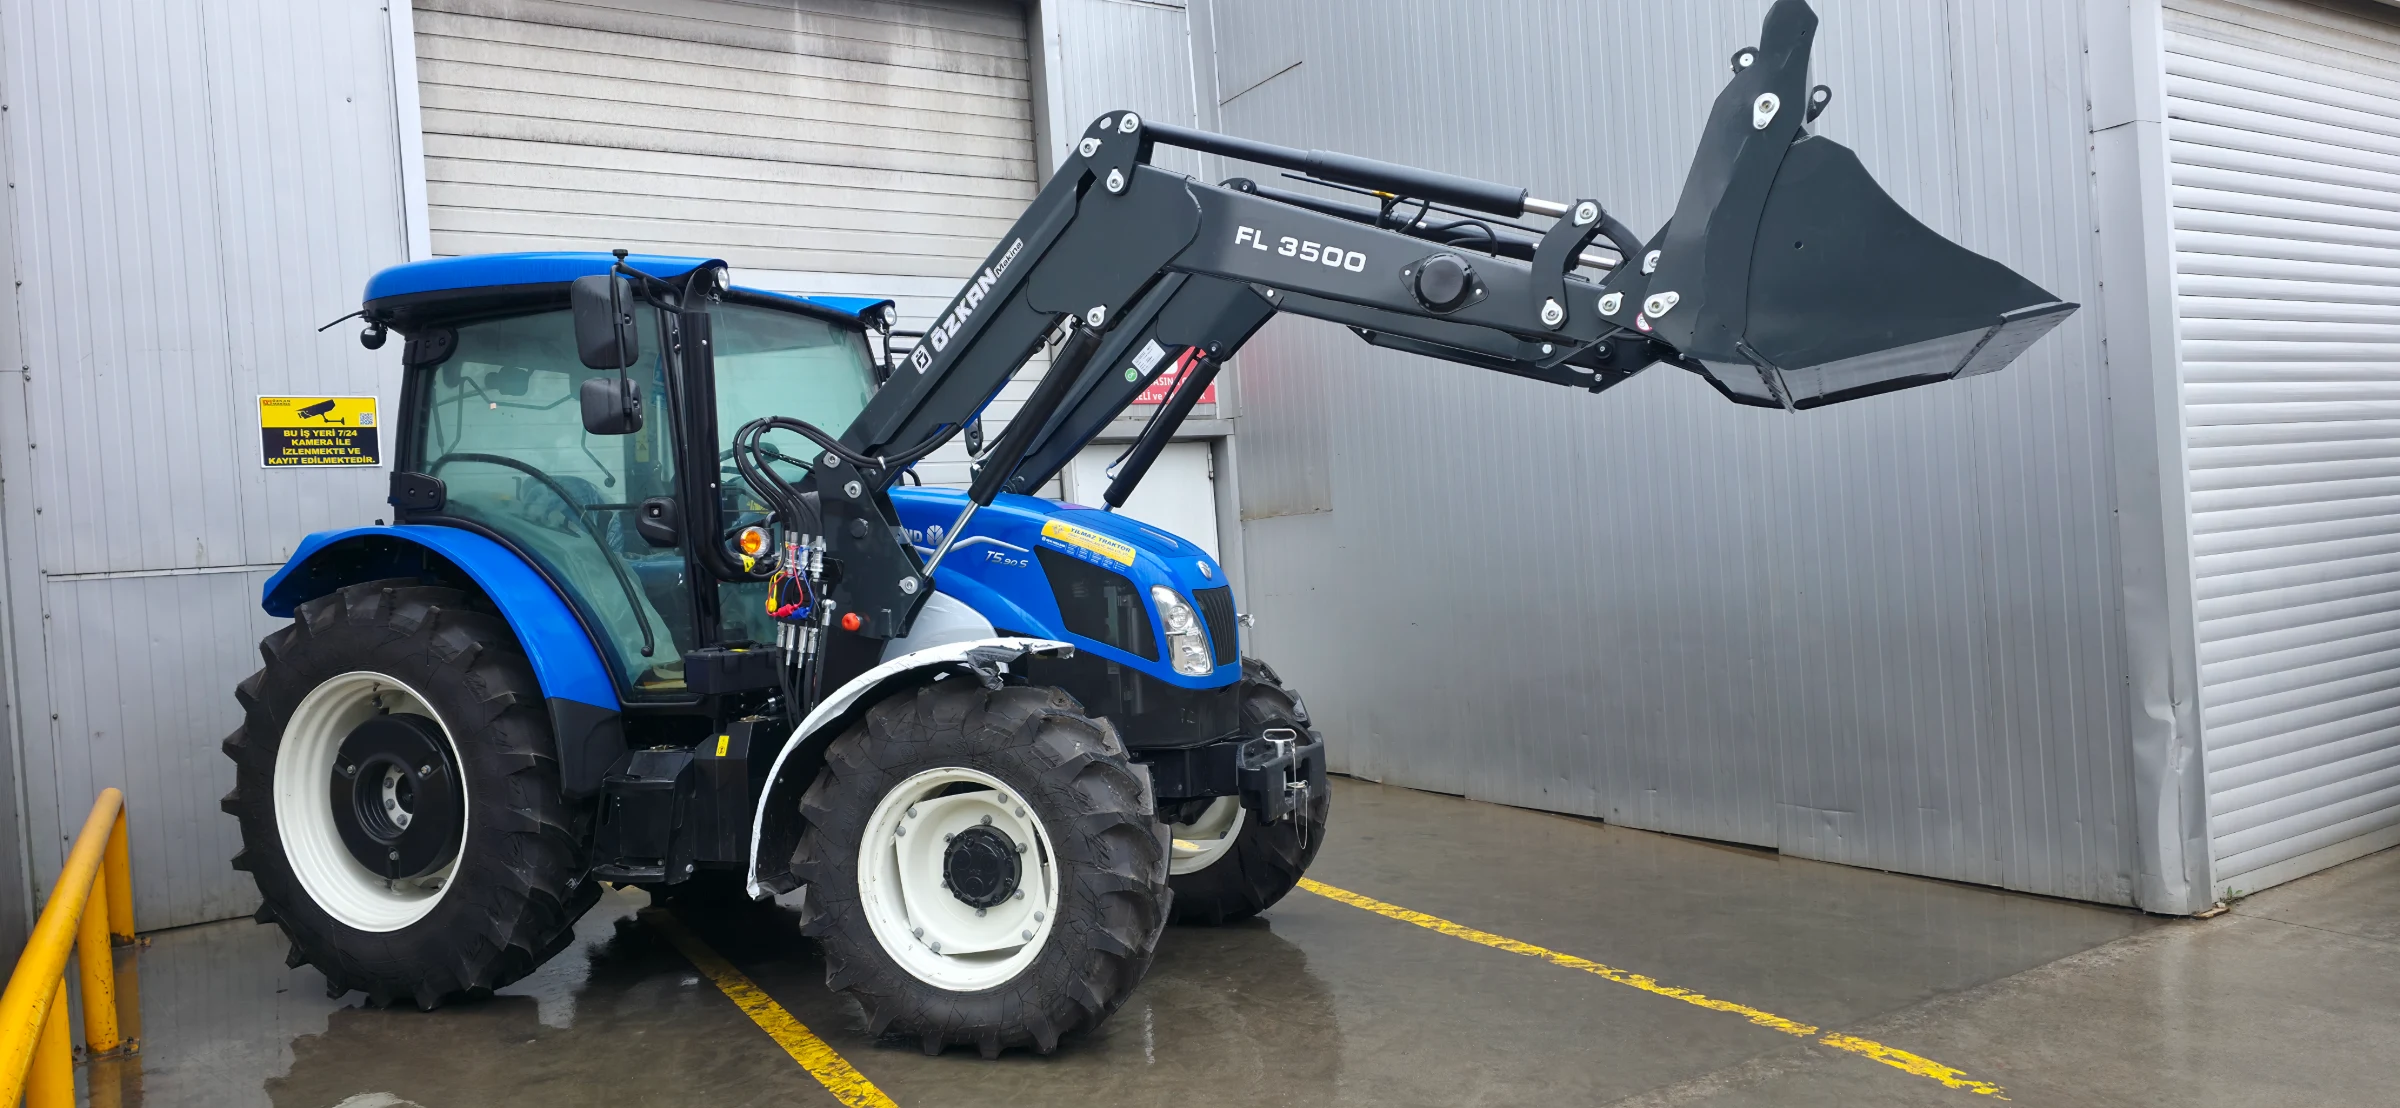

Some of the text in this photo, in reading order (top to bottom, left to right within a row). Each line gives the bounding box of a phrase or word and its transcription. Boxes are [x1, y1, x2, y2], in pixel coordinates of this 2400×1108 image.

[1234, 225, 1367, 273] FL 3500
[930, 240, 1023, 353] ÖZKAN Makina
[283, 428, 358, 439] BU İŞ YERİ 7/24
[291, 437, 351, 446] KAMERA İLE
[282, 446, 361, 455] İZLENMEKTE VE
[268, 455, 376, 465] KAYIT EDİLMEKTEDİR.
